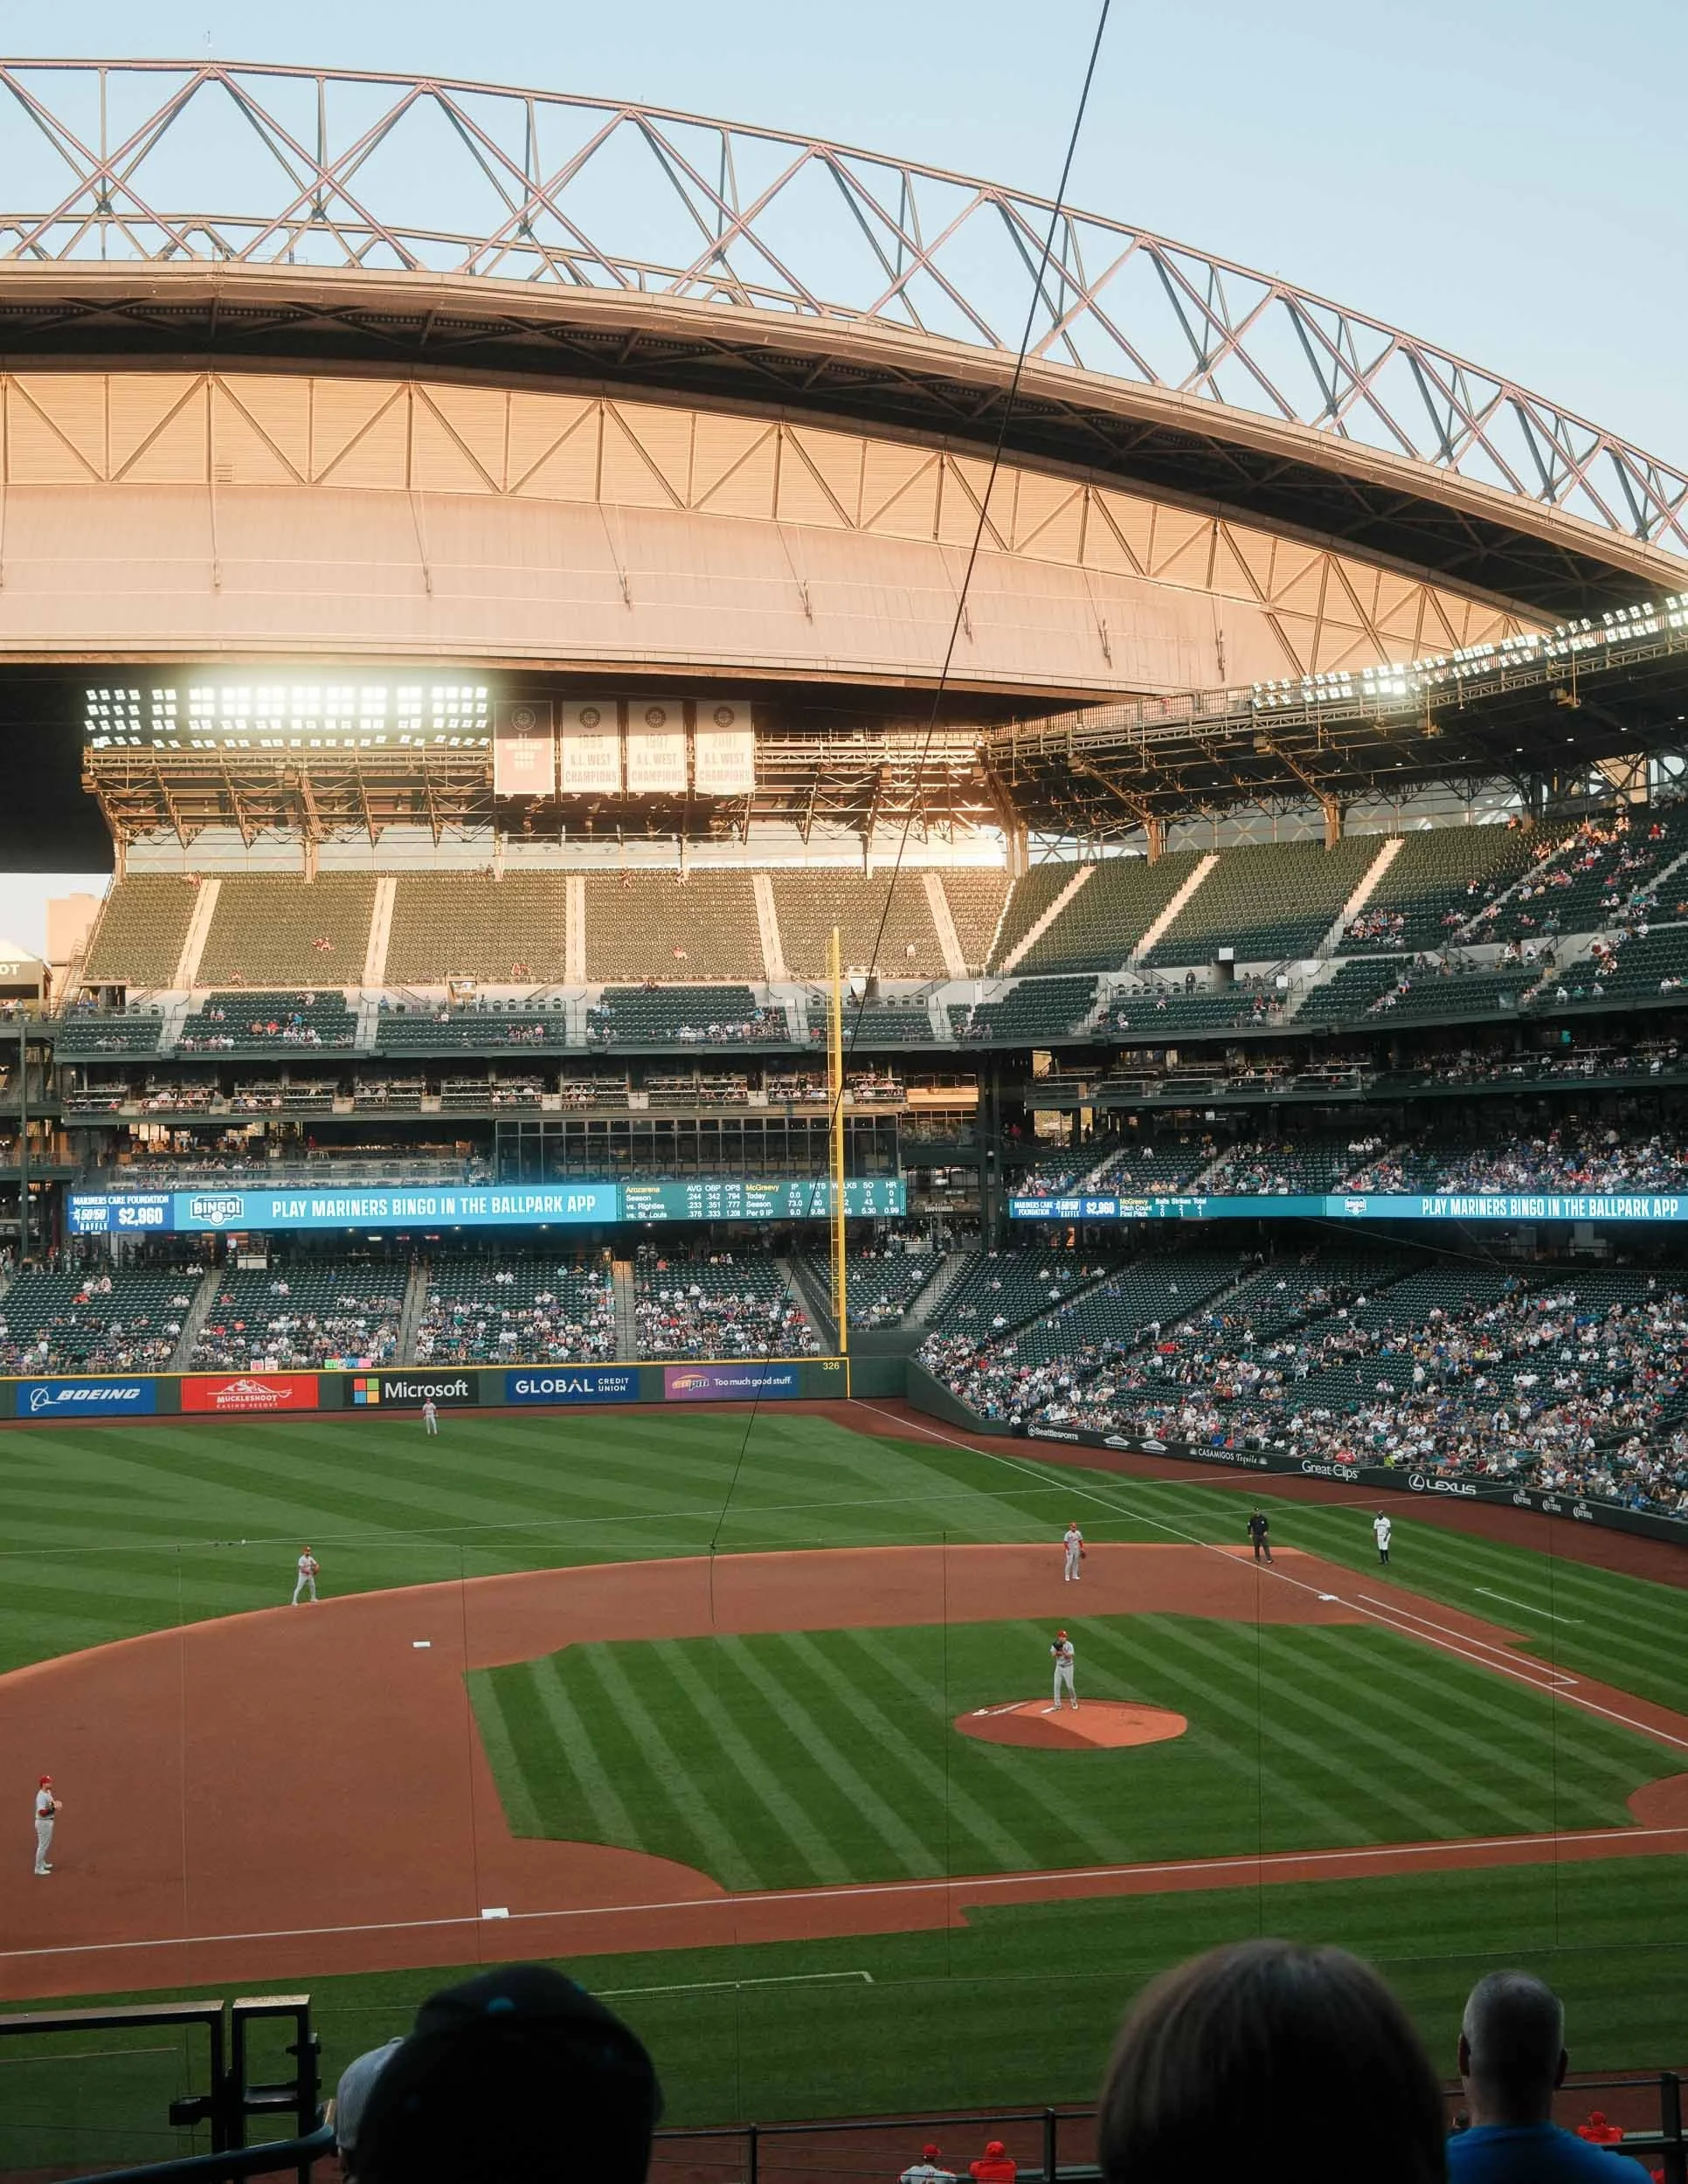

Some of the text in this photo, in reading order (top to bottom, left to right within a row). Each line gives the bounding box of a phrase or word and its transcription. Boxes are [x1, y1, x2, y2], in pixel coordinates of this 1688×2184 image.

[587, 753, 611, 766] WEST
[653, 753, 677, 765] WEST
[720, 752, 744, 765] WEST
[565, 771, 617, 784] CHAMPIONS
[632, 770, 683, 784] CHAMPIONS
[73, 1195, 169, 1206] MARINERS CARE FOUNDATION
[272, 1195, 597, 1218] PLAY MARINERS BINGO IN THE BALLPARK APP
[193, 1201, 240, 1214] BINGO!
[1086, 1201, 1115, 1216] $2,960
[1422, 1199, 1678, 1217] PLAY MARINERS BINGO IN THE BALLPARK APP
[822, 1362, 840, 1371] 326
[515, 1379, 594, 1394] GLOBAL
[598, 1377, 630, 1386] CREDIT
[729, 1377, 751, 1386] much
[751, 1377, 772, 1387] good
[56, 1388, 141, 1401] BOEING
[384, 1379, 469, 1399] Microsoft
[598, 1384, 626, 1393] UNION
[216, 1395, 278, 1404] MUCKLESHOOT
[1198, 1448, 1235, 1461] CASAMIGOS
[1302, 1460, 1359, 1482] Great Clips
[1426, 1479, 1477, 1496] LEXUS
